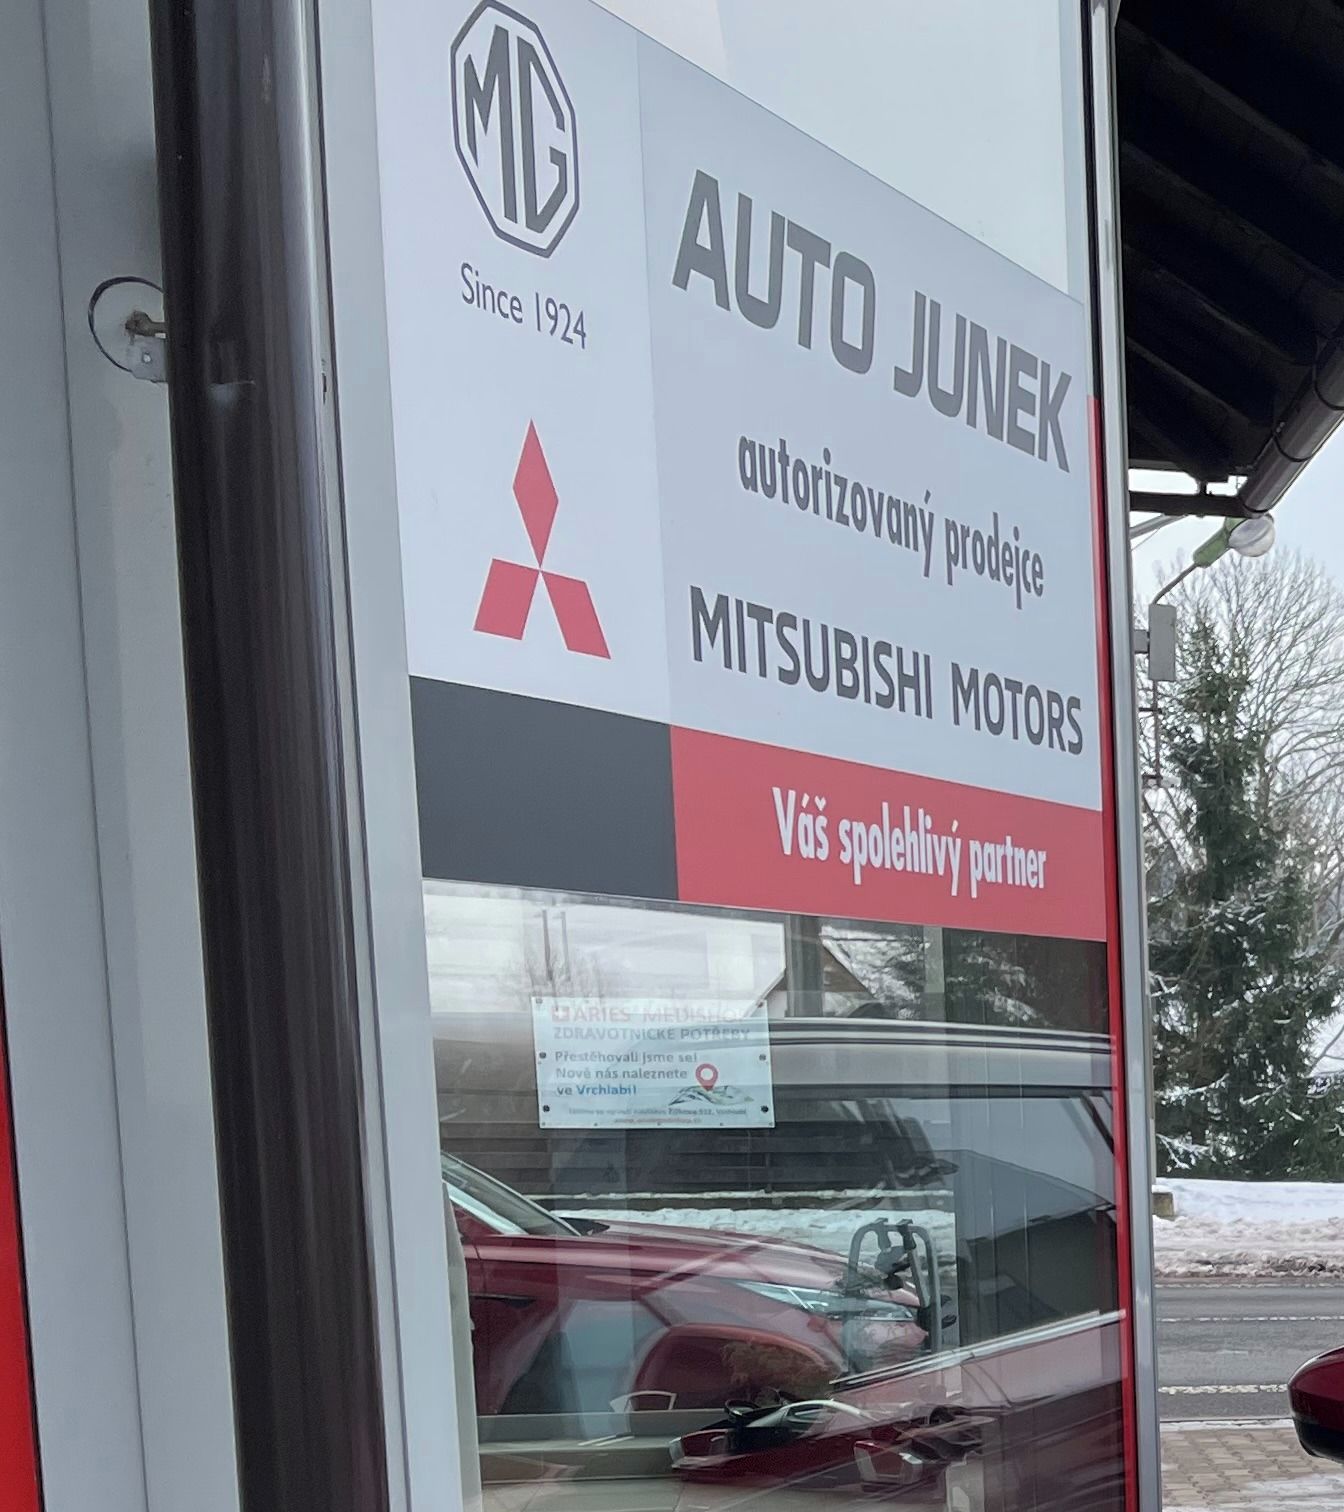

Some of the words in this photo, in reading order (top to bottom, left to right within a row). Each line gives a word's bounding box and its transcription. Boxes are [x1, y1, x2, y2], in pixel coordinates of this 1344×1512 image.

[463, 23, 568, 234] MG
[460, 262, 524, 324] Since
[535, 291, 587, 350] 1924
[671, 168, 877, 376] AUTO
[892, 289, 1073, 474] JUNEK
[737, 434, 935, 579] autorizovaný
[944, 511, 1044, 611] prodejce
[689, 584, 934, 720] MITSUBISHI
[950, 661, 1084, 756] MOTORS
[771, 786, 830, 862] Váš
[837, 801, 962, 897] spolehlivý
[968, 835, 1048, 899] partner
[556, 1086, 573, 1096] ve
[595, 1066, 619, 1079] nás
[622, 1067, 688, 1080] naleznete
